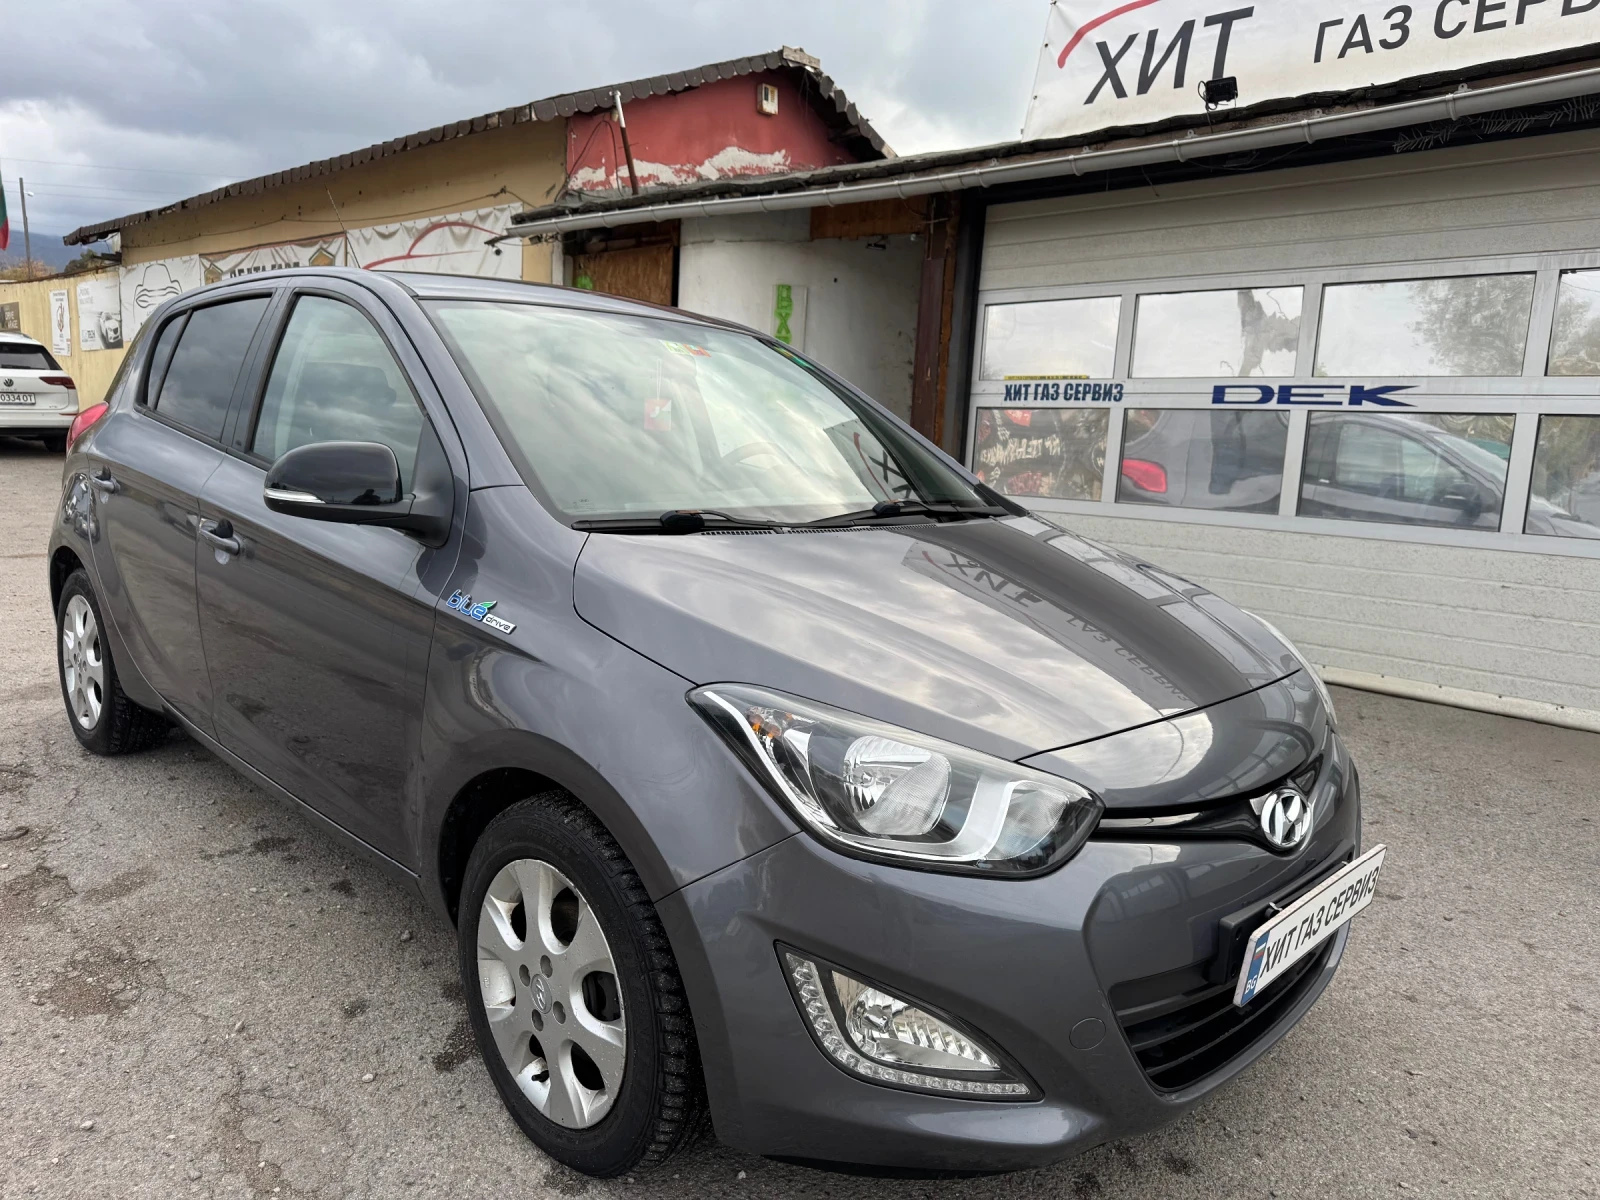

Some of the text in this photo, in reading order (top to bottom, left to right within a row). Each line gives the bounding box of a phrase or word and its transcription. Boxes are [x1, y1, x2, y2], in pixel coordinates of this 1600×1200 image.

[1083, 6, 1254, 105] ХИТ
[1313, 5, 1412, 63] ГАЗ
[1003, 383, 1124, 402] ХИТ ГАЗ СЕРВИЗ
[1211, 385, 1420, 408] DEK
[446, 589, 511, 631] blue drive
[1259, 866, 1380, 978] ХИТ ГАЗ СЕРВИЗ
[1244, 975, 1258, 995] BG
